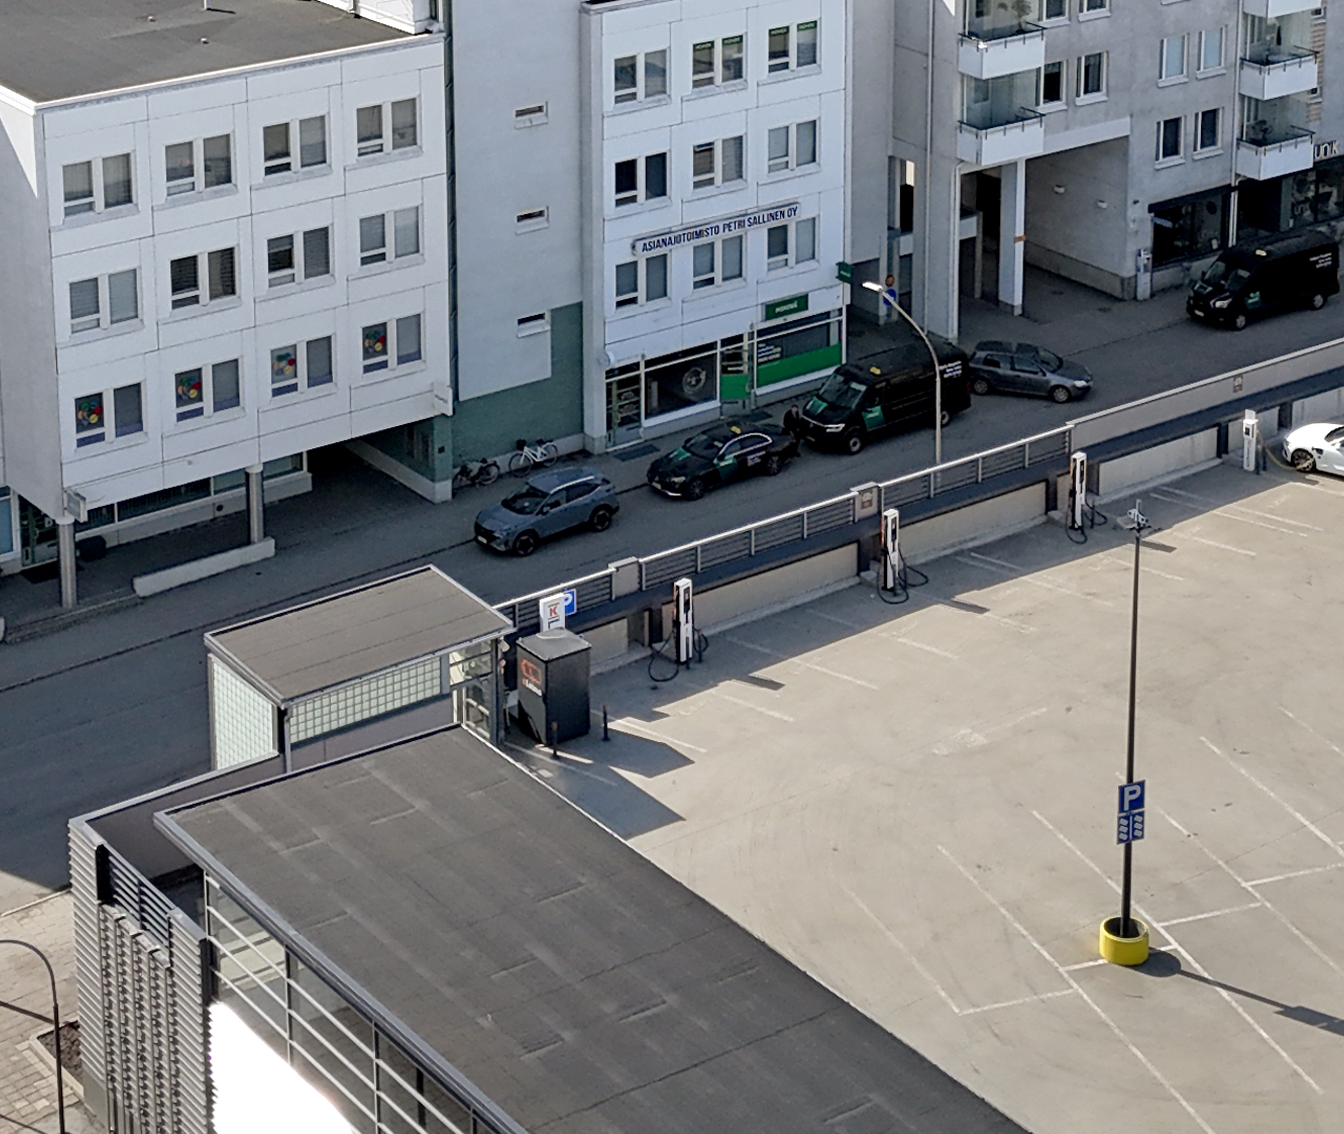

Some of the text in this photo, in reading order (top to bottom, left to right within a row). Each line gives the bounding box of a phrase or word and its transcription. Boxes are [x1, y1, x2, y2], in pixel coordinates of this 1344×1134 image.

[641, 225, 720, 253] ASIANAJOTOIMISTO
[722, 218, 746, 234] PETRI
[747, 208, 785, 228] SALLINEN
[1124, 785, 1141, 811] P
